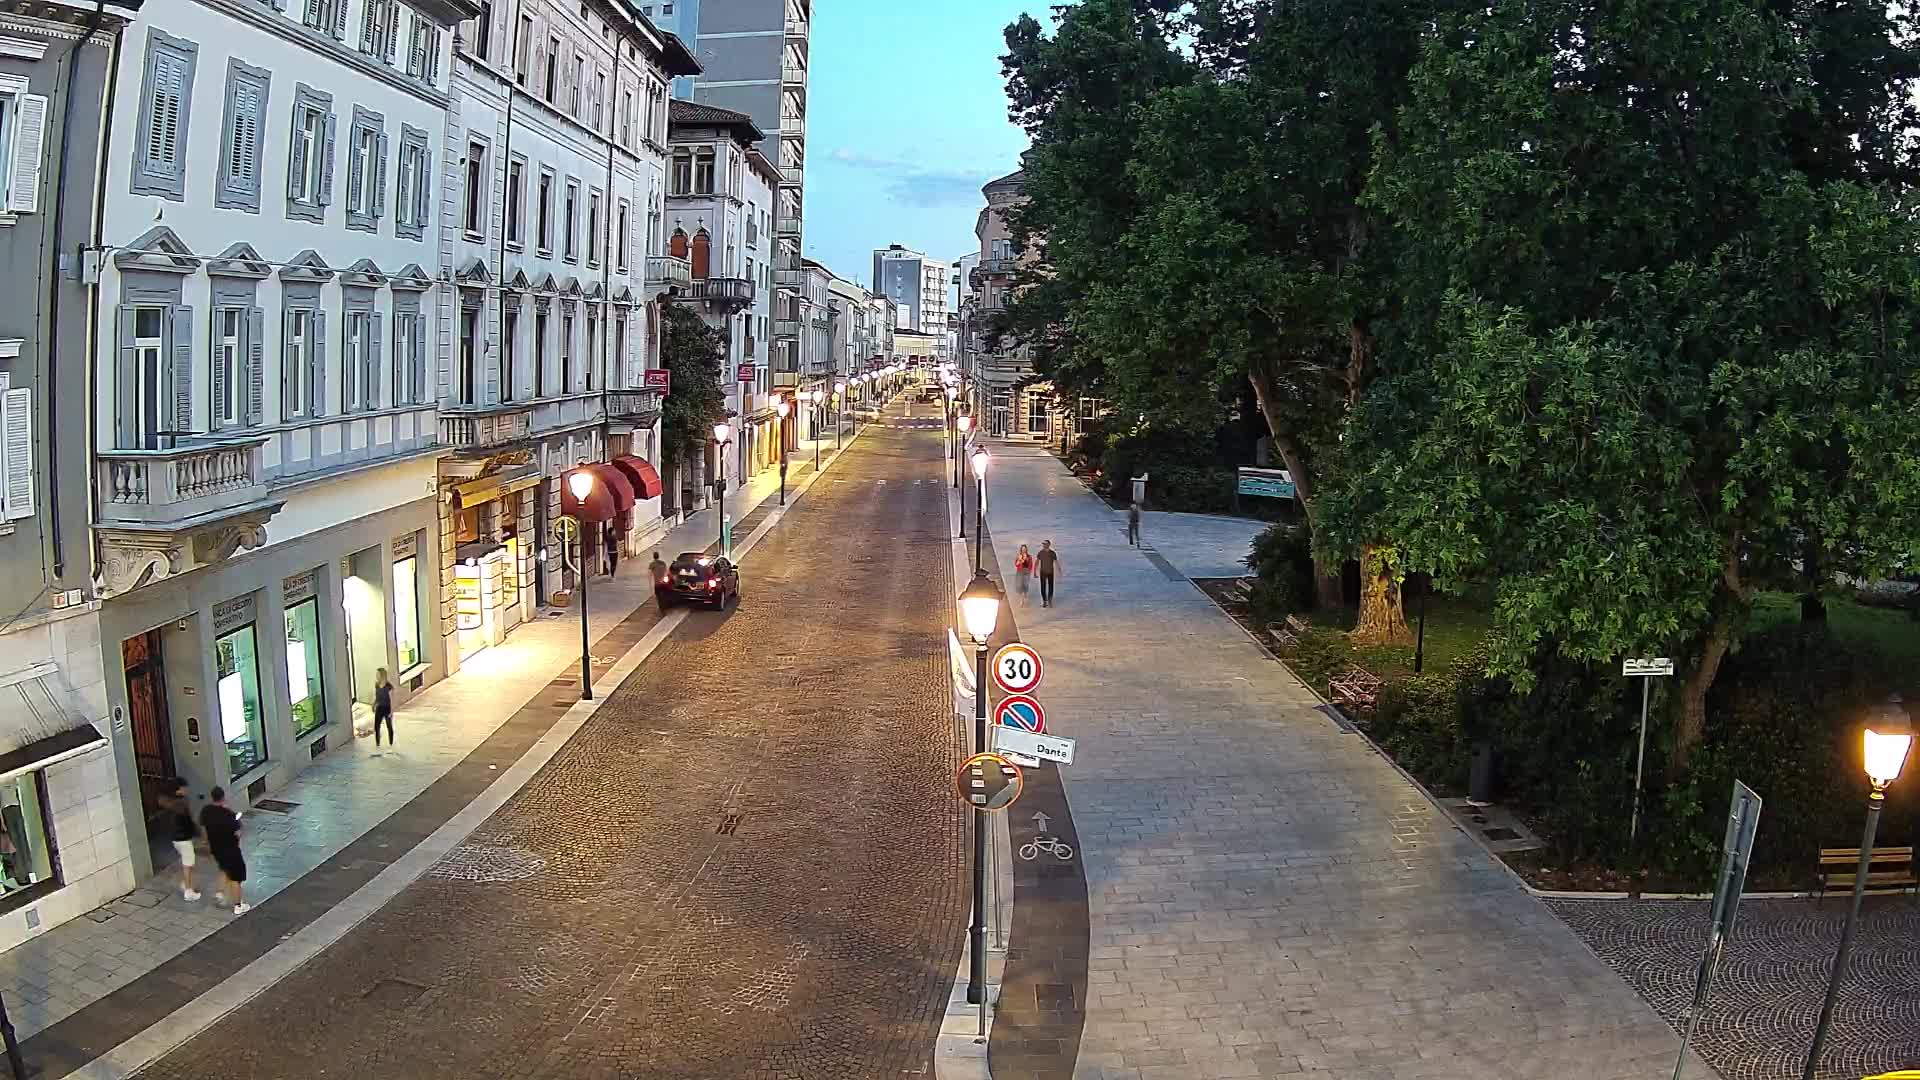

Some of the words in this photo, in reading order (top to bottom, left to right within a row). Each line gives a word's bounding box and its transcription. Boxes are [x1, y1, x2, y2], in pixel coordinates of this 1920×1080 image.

[213, 611, 243, 628] OPERATIVO
[1005, 659, 1031, 679] 30
[1037, 744, 1067, 757] Dante
